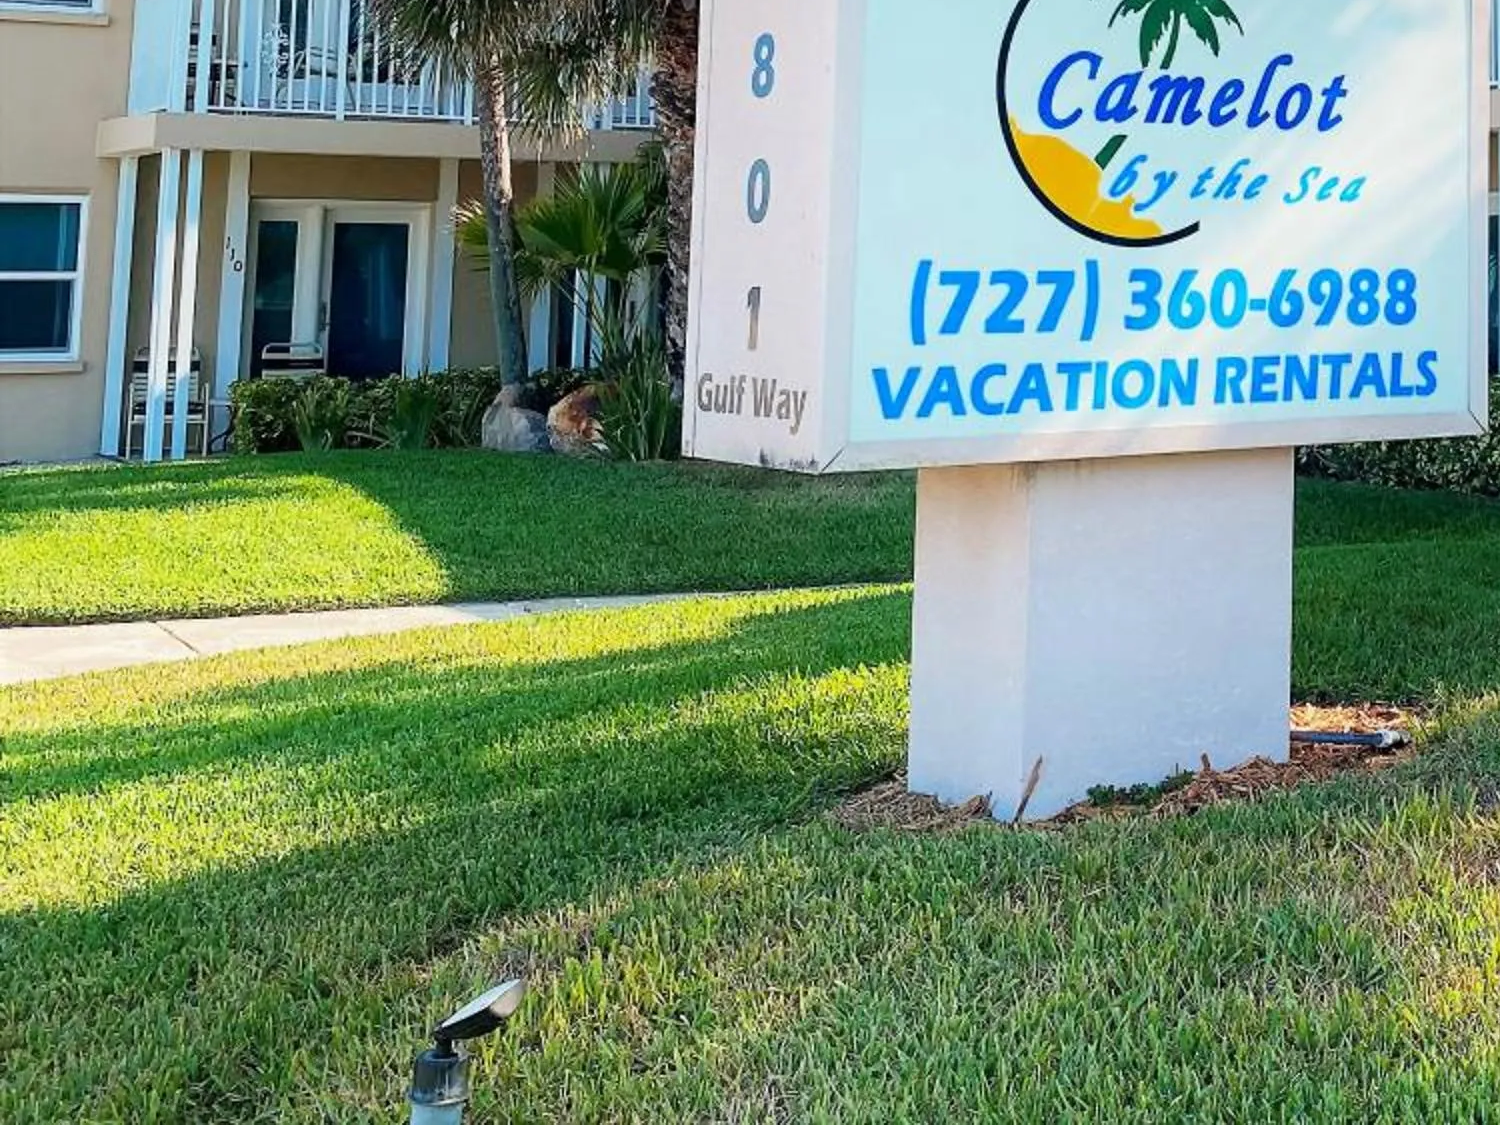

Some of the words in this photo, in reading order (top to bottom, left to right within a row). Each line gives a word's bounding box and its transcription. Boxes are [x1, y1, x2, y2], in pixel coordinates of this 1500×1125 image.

[1037, 50, 1349, 132] Camelot
[1108, 154, 1178, 212] by
[1189, 158, 1269, 201] the
[1283, 166, 1367, 205] Sea
[225, 235, 243, 272] 110
[910, 259, 1100, 346] (727)
[1123, 268, 1418, 332] 360-6988
[697, 372, 747, 415] Gulf
[752, 377, 808, 435] Way
[871, 358, 1199, 420] VACATION
[1215, 350, 1438, 405] RENTALS
